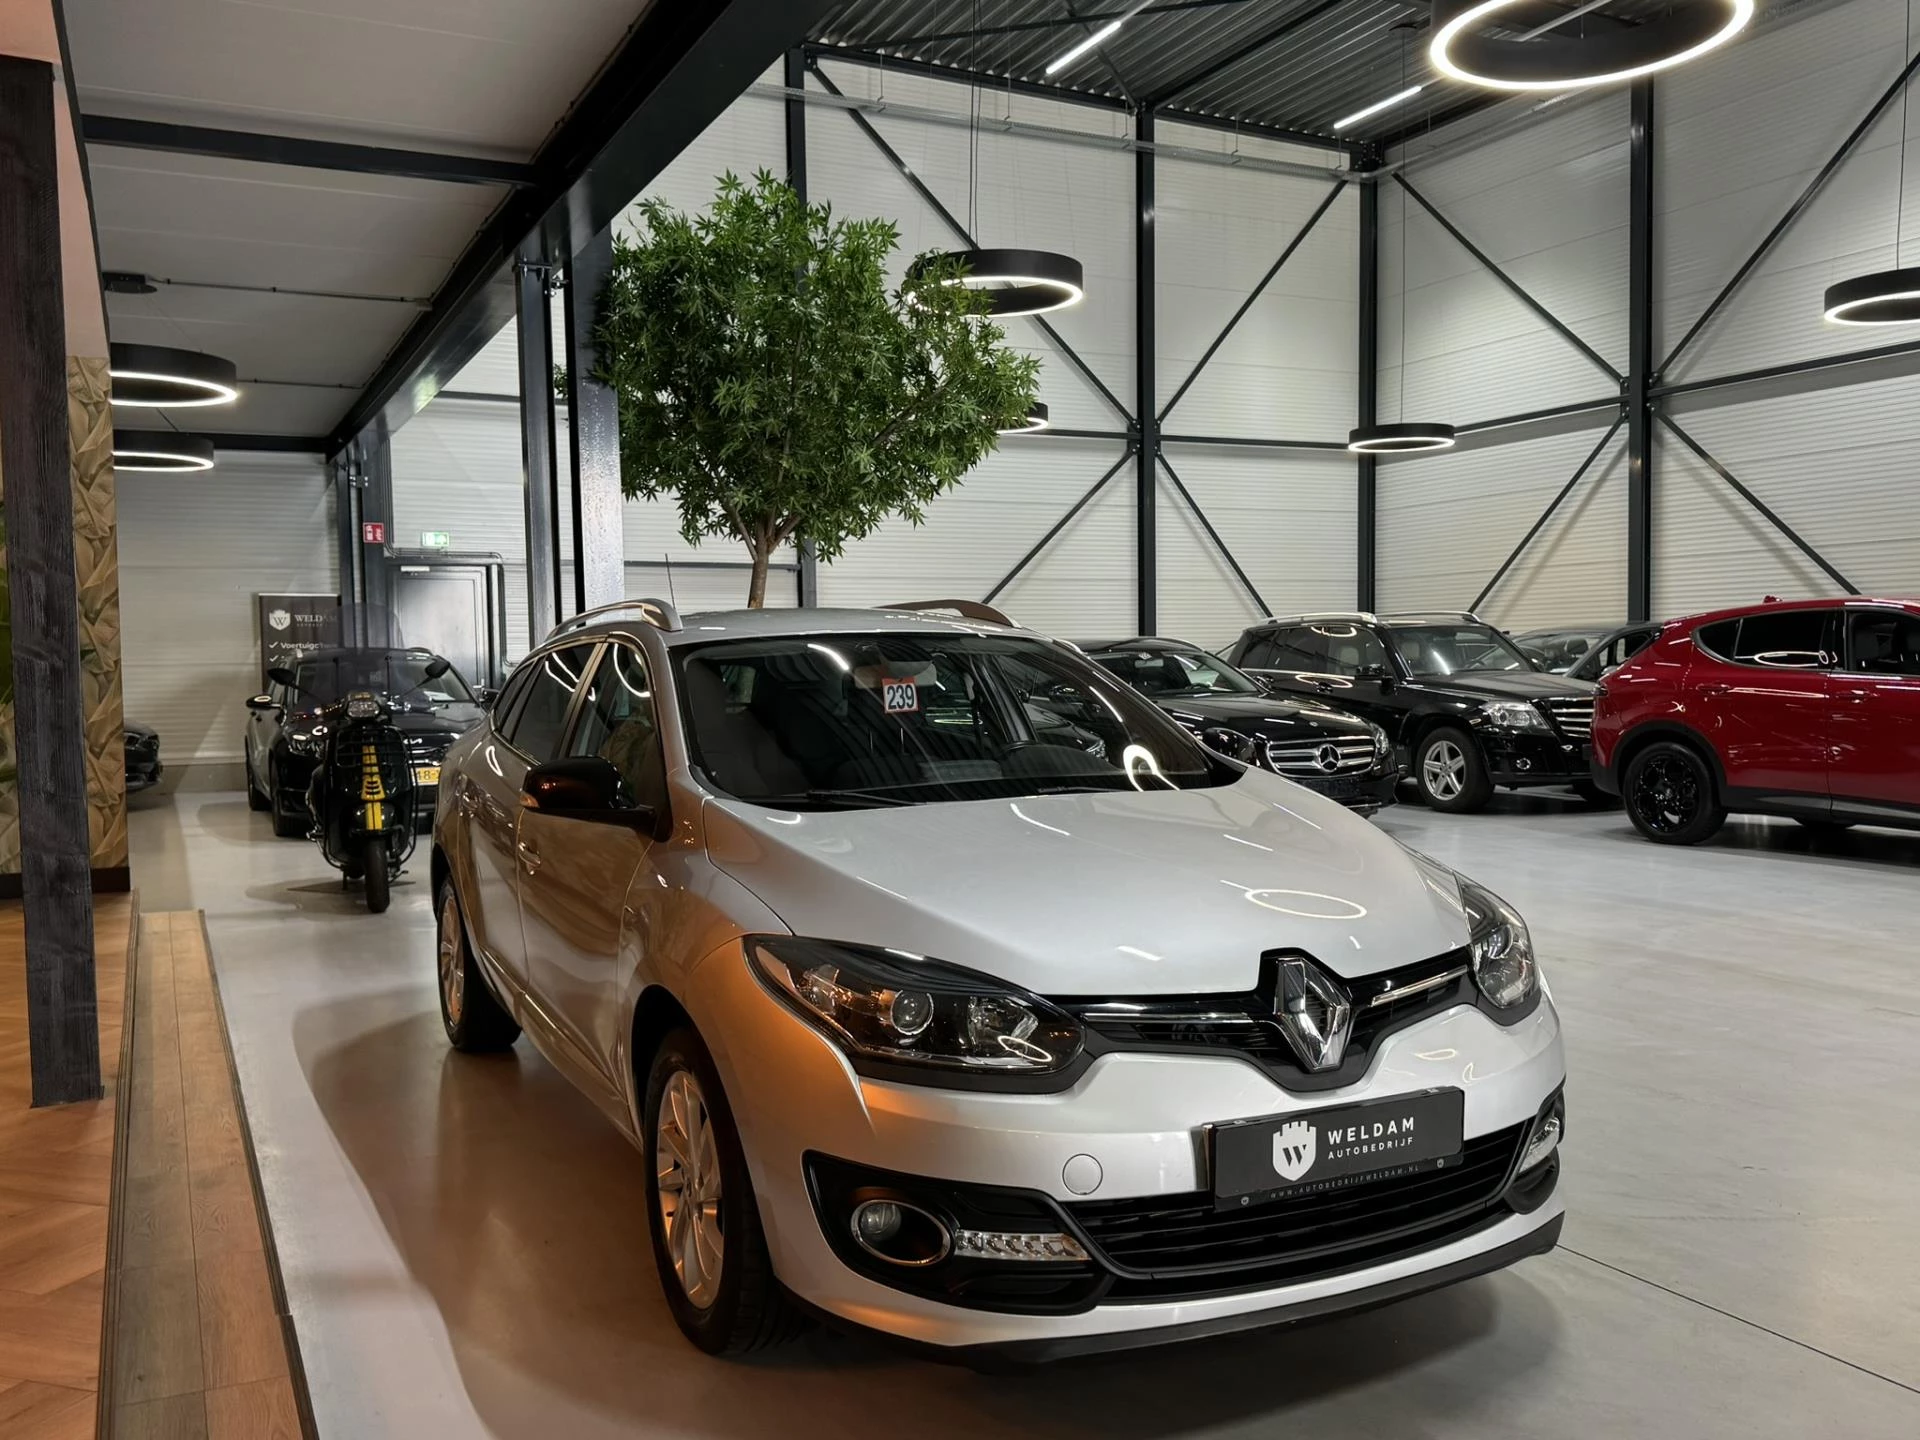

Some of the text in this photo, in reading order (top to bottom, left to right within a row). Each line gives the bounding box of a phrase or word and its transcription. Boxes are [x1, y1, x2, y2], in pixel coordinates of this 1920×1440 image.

[887, 684, 915, 710] 239
[1328, 1116, 1414, 1145] WELDAM
[1328, 1137, 1413, 1160] AUTOBEDRIJF
